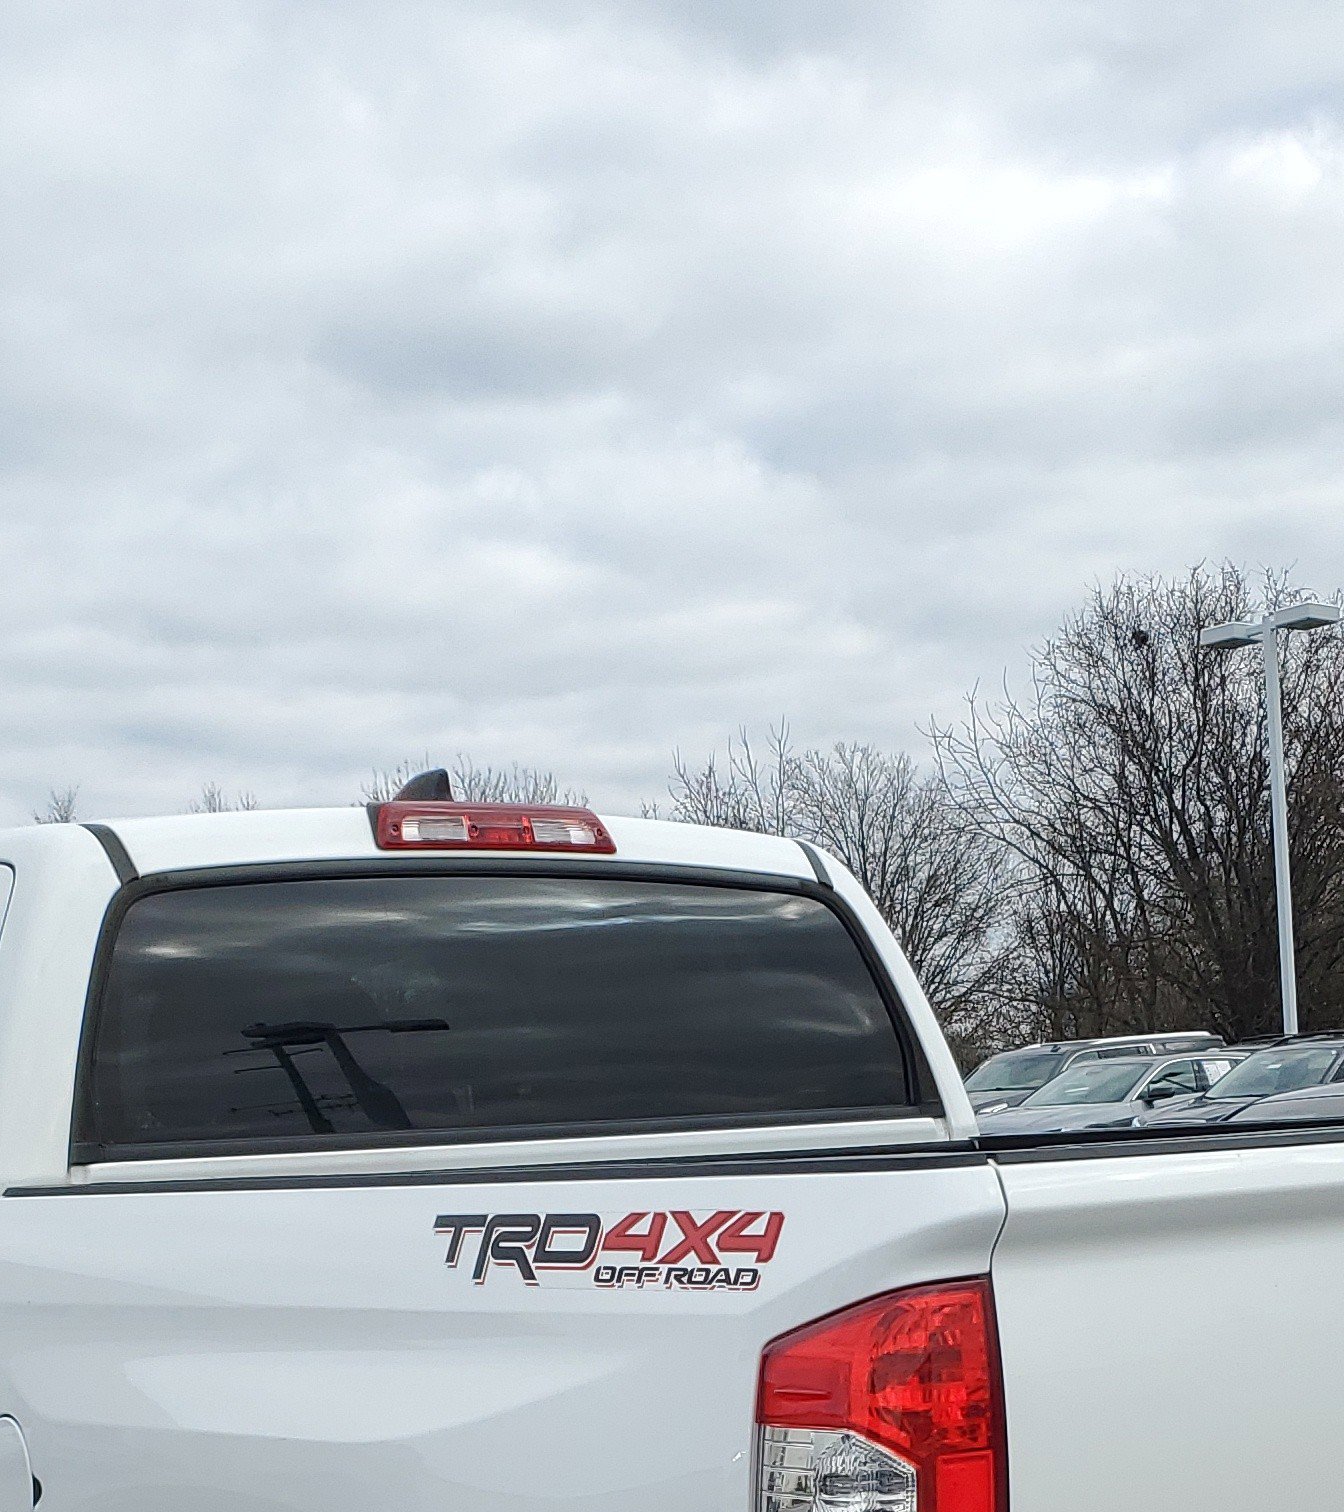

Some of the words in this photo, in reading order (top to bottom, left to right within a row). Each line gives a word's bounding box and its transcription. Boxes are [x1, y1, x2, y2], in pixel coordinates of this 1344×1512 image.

[433, 1212, 605, 1287] TRD
[601, 1210, 786, 1265] 4X4
[593, 1265, 660, 1288] OFF
[662, 1267, 762, 1291] ROAD
